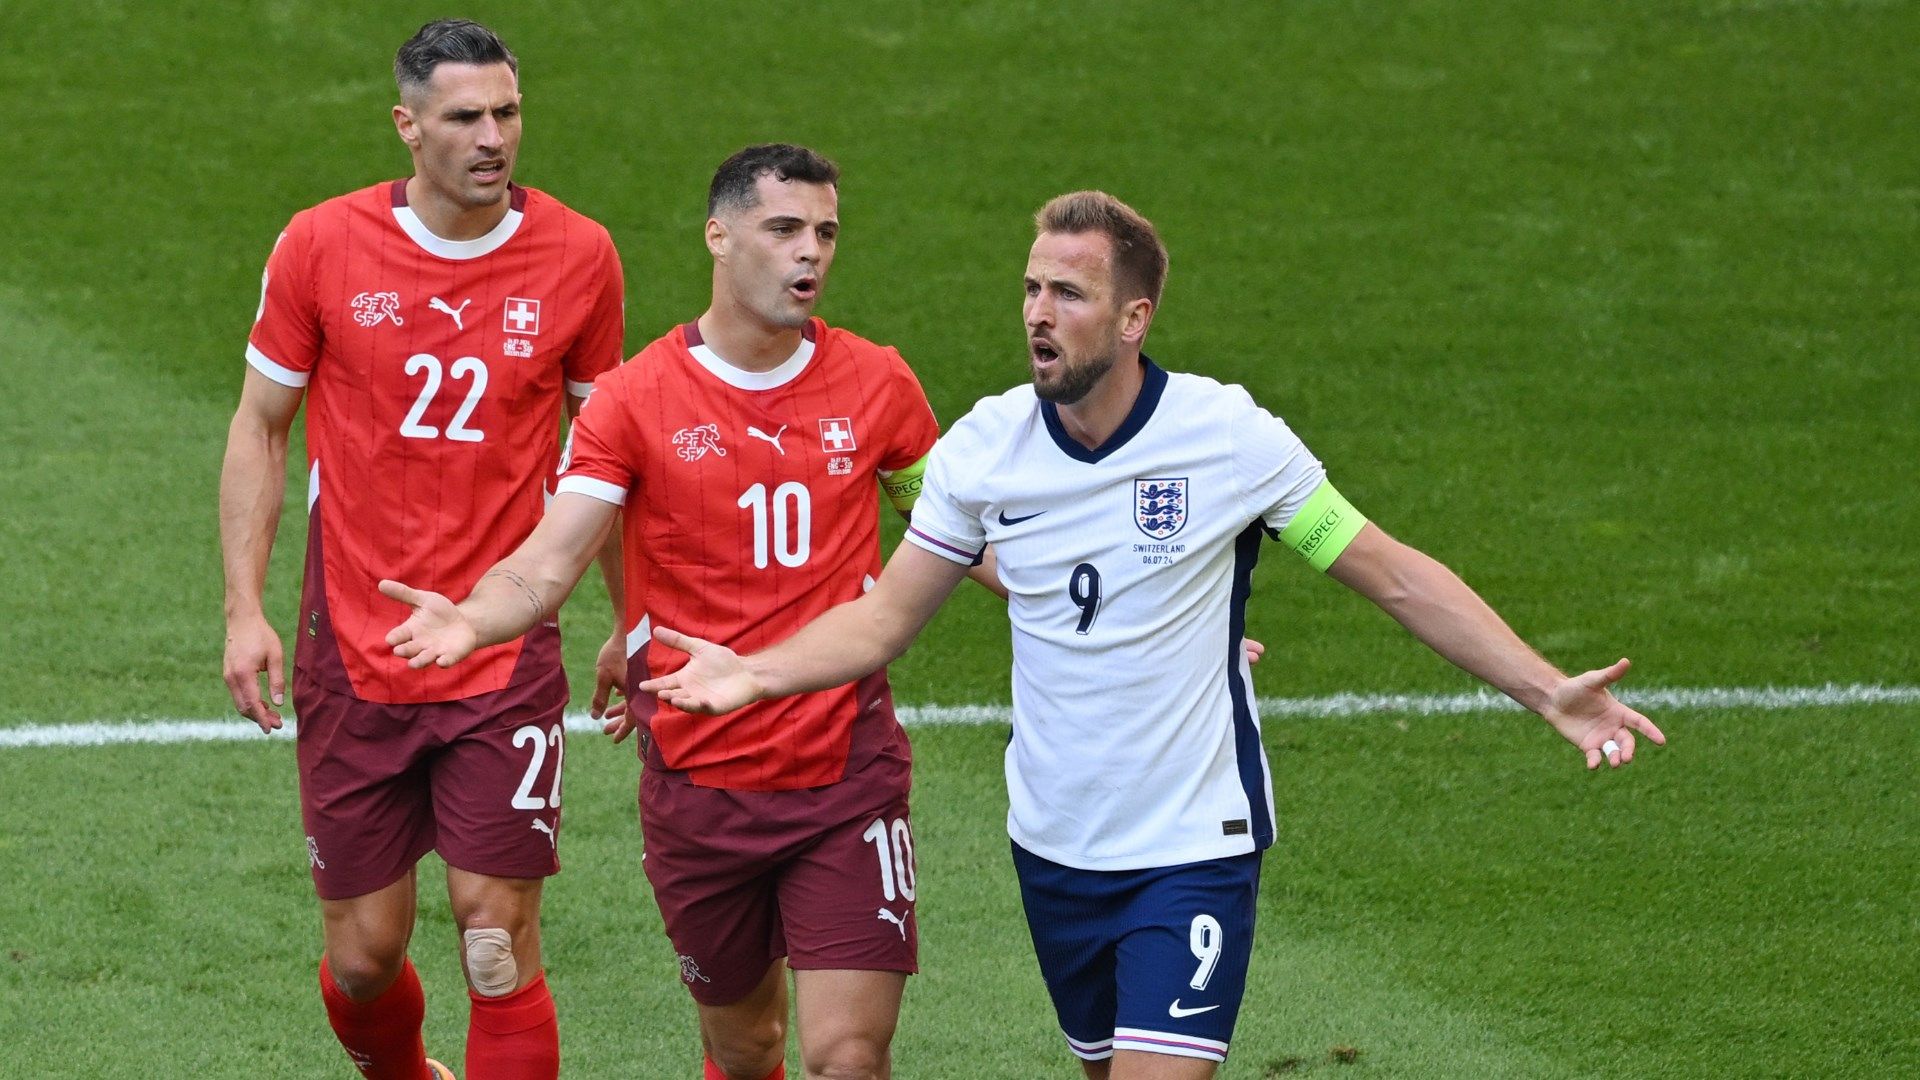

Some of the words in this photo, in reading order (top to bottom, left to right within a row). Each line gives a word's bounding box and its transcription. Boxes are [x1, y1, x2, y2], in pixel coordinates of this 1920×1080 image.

[399, 354, 489, 442] 22
[888, 476, 924, 495] SPECT
[738, 481, 811, 570] 10
[1132, 543, 1186, 554] SWITZERLAND
[1142, 555, 1173, 565] 06.07.24
[1301, 509, 1340, 553] RESPECT
[1068, 562, 1103, 636] 9
[511, 724, 564, 810] 22
[863, 818, 916, 902] 10
[1189, 914, 1222, 991] 9
